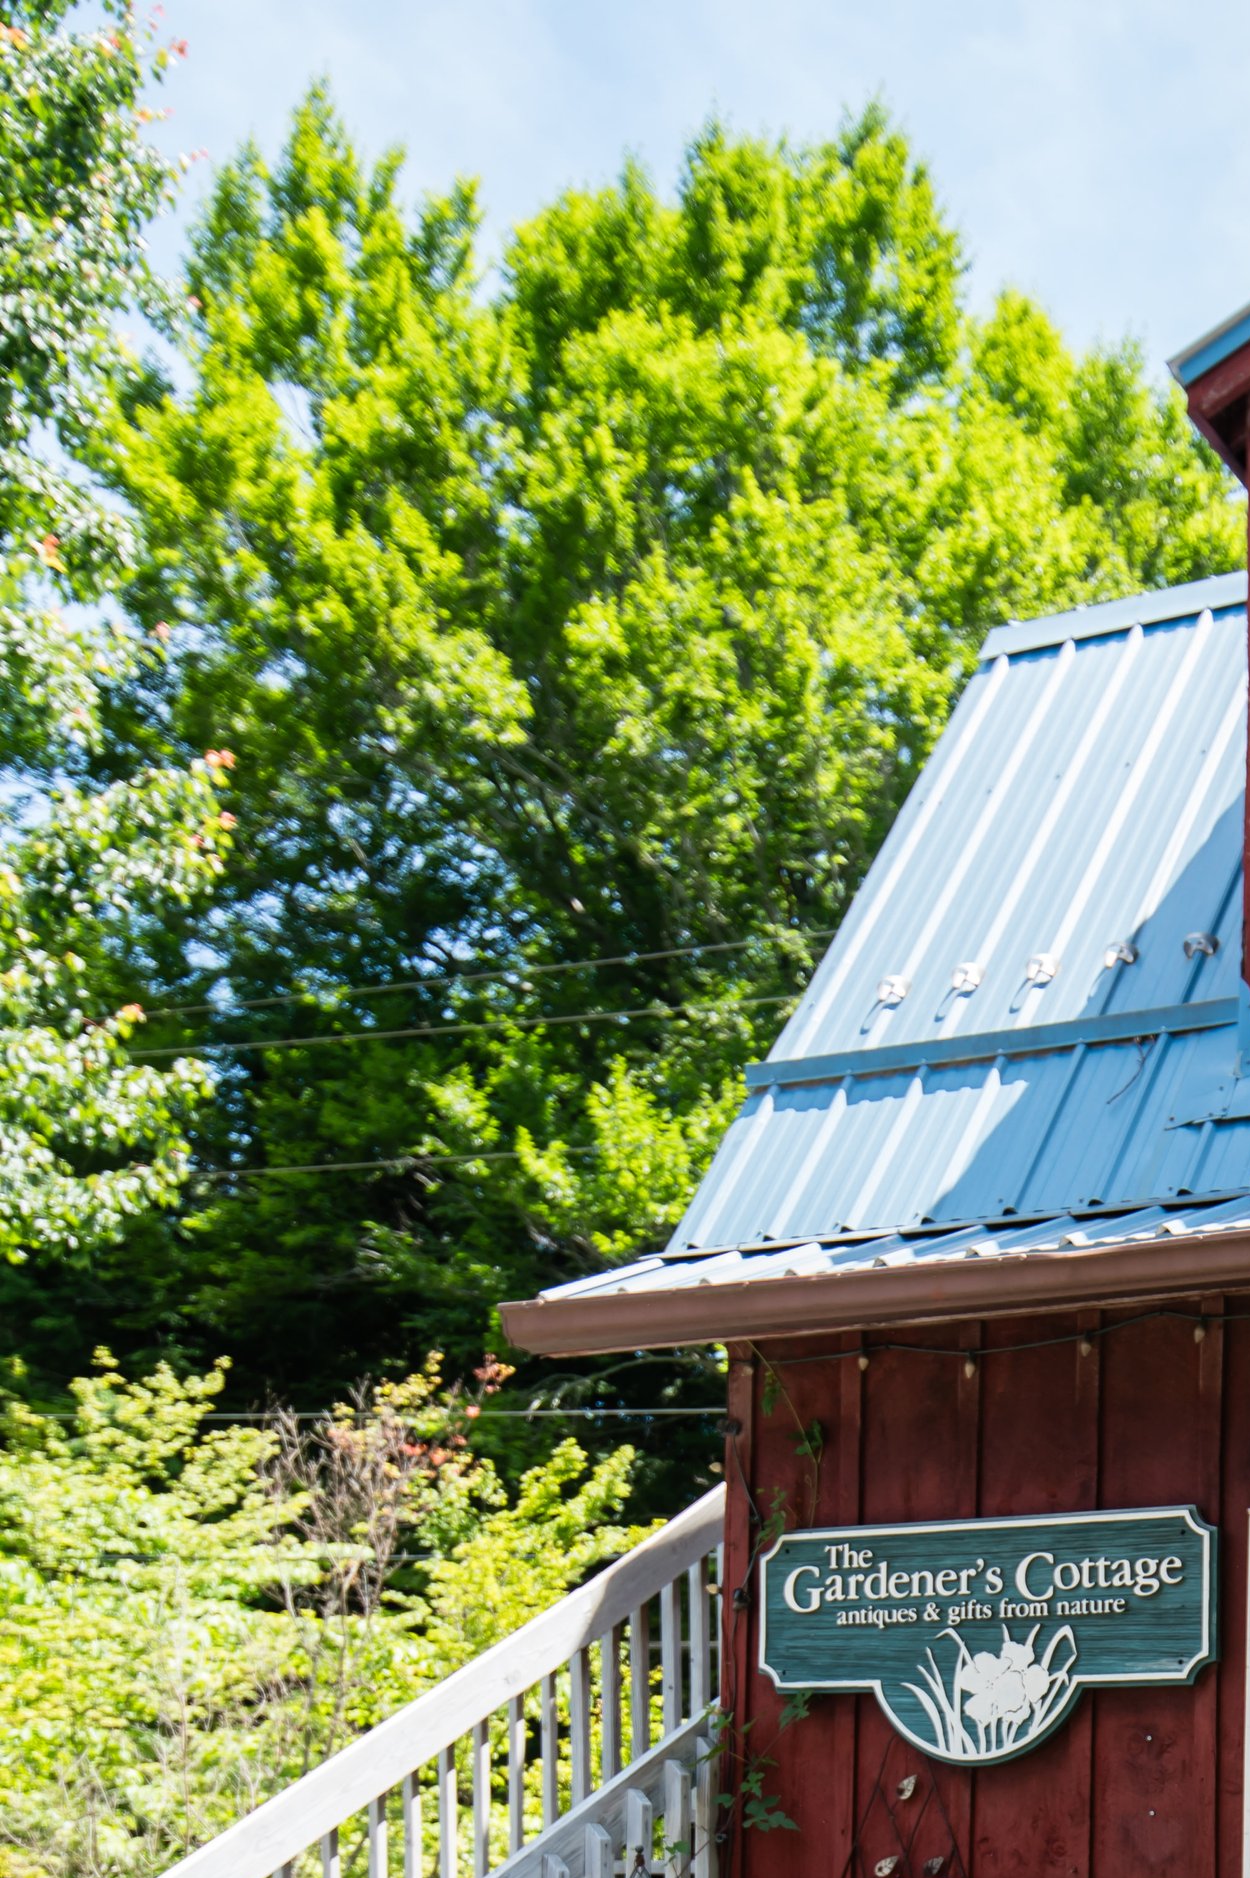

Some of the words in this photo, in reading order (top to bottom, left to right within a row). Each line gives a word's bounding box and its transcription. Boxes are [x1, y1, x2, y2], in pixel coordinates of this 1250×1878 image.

[824, 1543, 873, 1569] The
[784, 1558, 1003, 1613] Gardener's
[1015, 1552, 1183, 1601] Cottage
[836, 1605, 918, 1629] antiques
[923, 1602, 941, 1622] &
[947, 1599, 992, 1626] gifts
[999, 1598, 1049, 1618] from
[1056, 1598, 1126, 1616] nature
